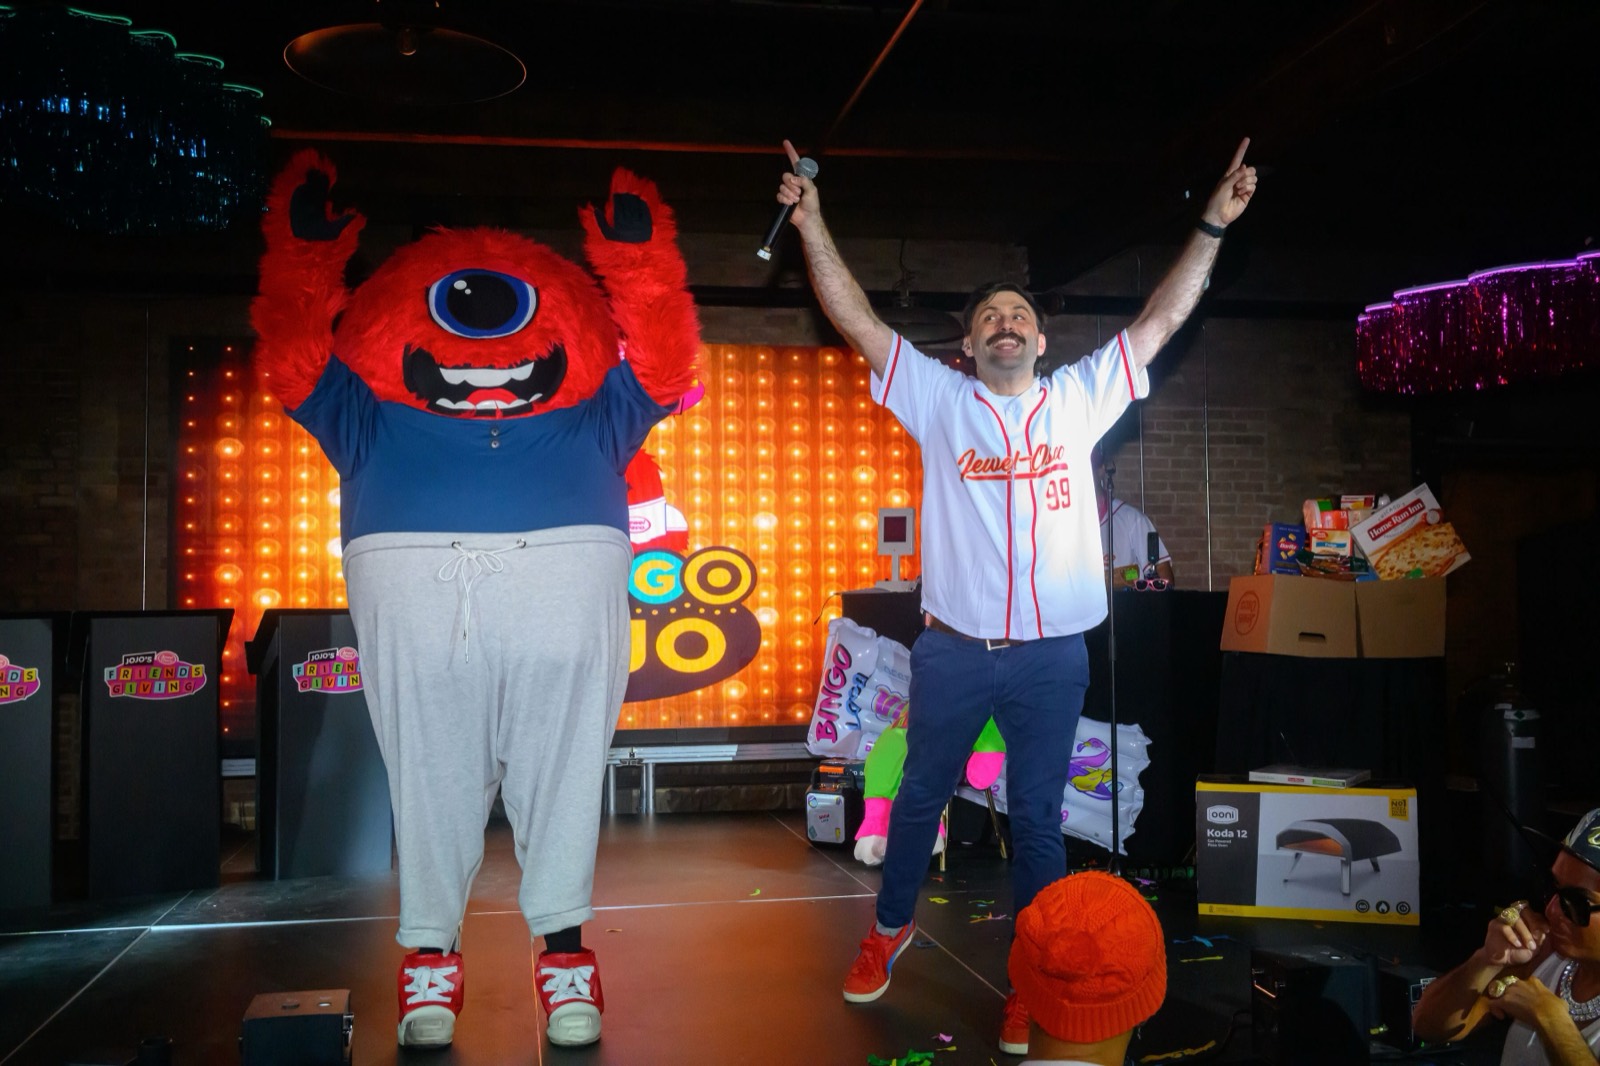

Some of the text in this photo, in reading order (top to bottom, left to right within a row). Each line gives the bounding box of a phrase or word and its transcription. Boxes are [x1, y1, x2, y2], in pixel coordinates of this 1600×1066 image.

[1046, 477, 1071, 511] 99
[1369, 521, 1393, 538] Home
[1392, 511, 1409, 525] Run
[1408, 502, 1423, 515] Inn
[125, 655, 153, 666] JOJO'S
[311, 652, 335, 662] JOJO'S
[108, 666, 202, 680] FRIENDS
[112, 681, 193, 694] GIVING
[815, 643, 852, 743] BINGO
[1211, 810, 1235, 819] ooni
[1206, 828, 1248, 839] Koda 12
